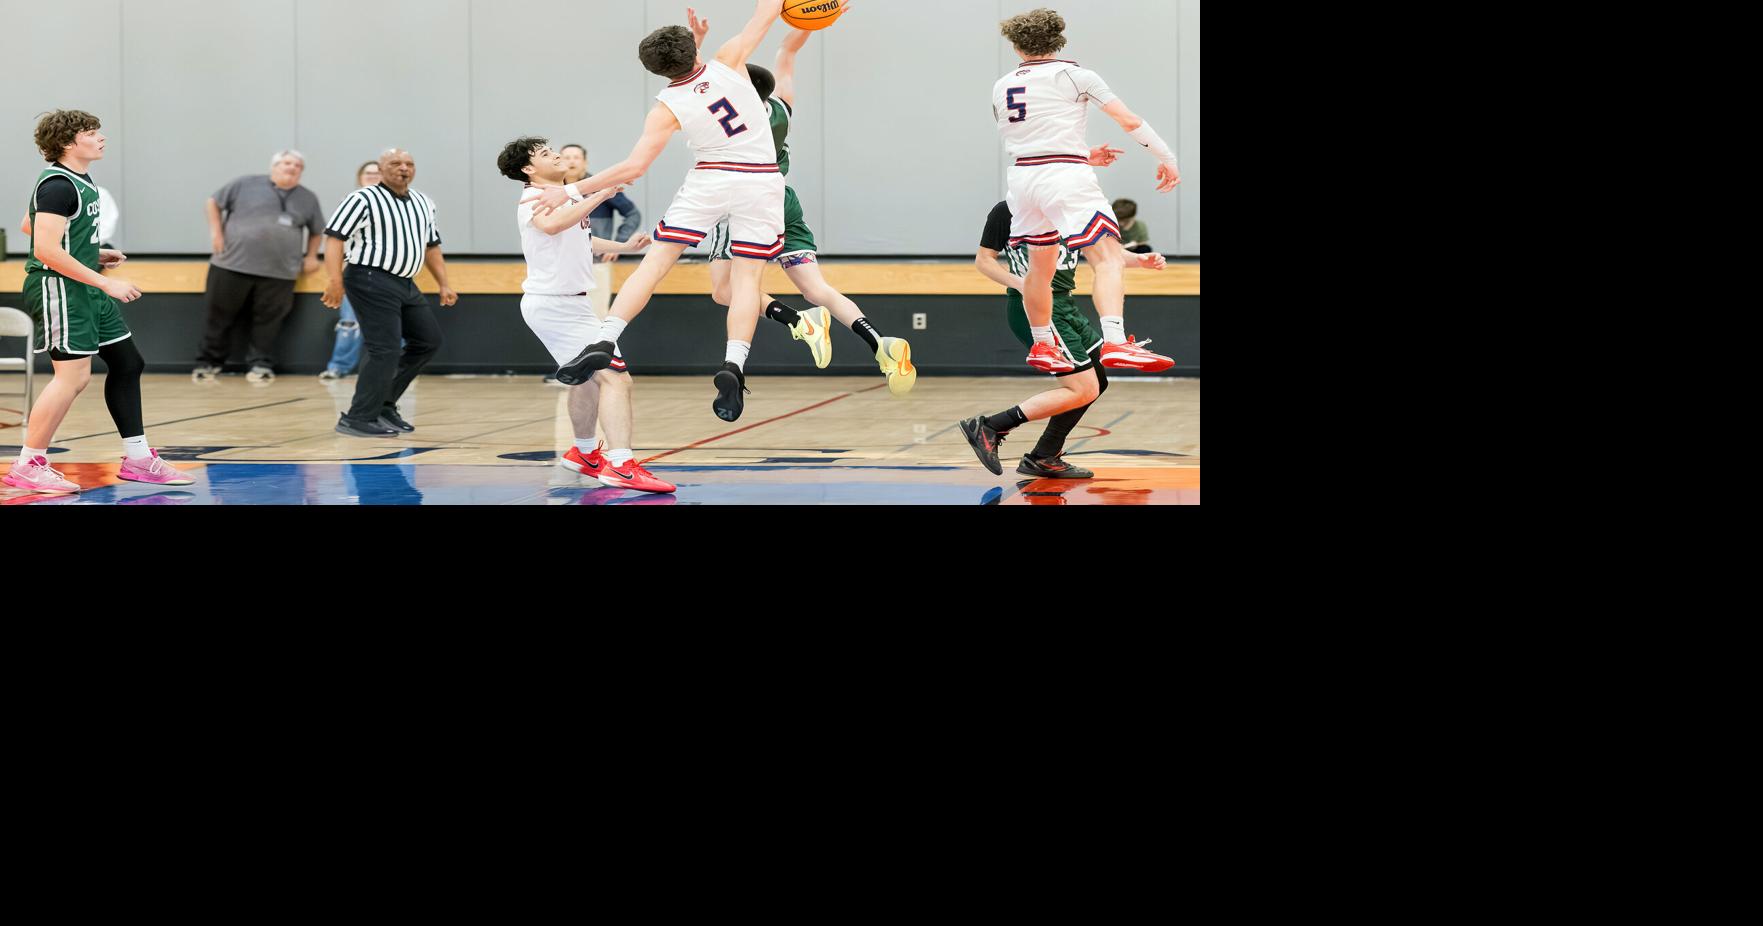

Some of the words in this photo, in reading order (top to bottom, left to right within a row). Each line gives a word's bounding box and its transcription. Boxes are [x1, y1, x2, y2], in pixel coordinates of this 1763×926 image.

[801, 0, 839, 14] Wilson
[707, 96, 748, 138] 2
[1006, 86, 1027, 123] 5
[1056, 244, 1079, 270] 23
